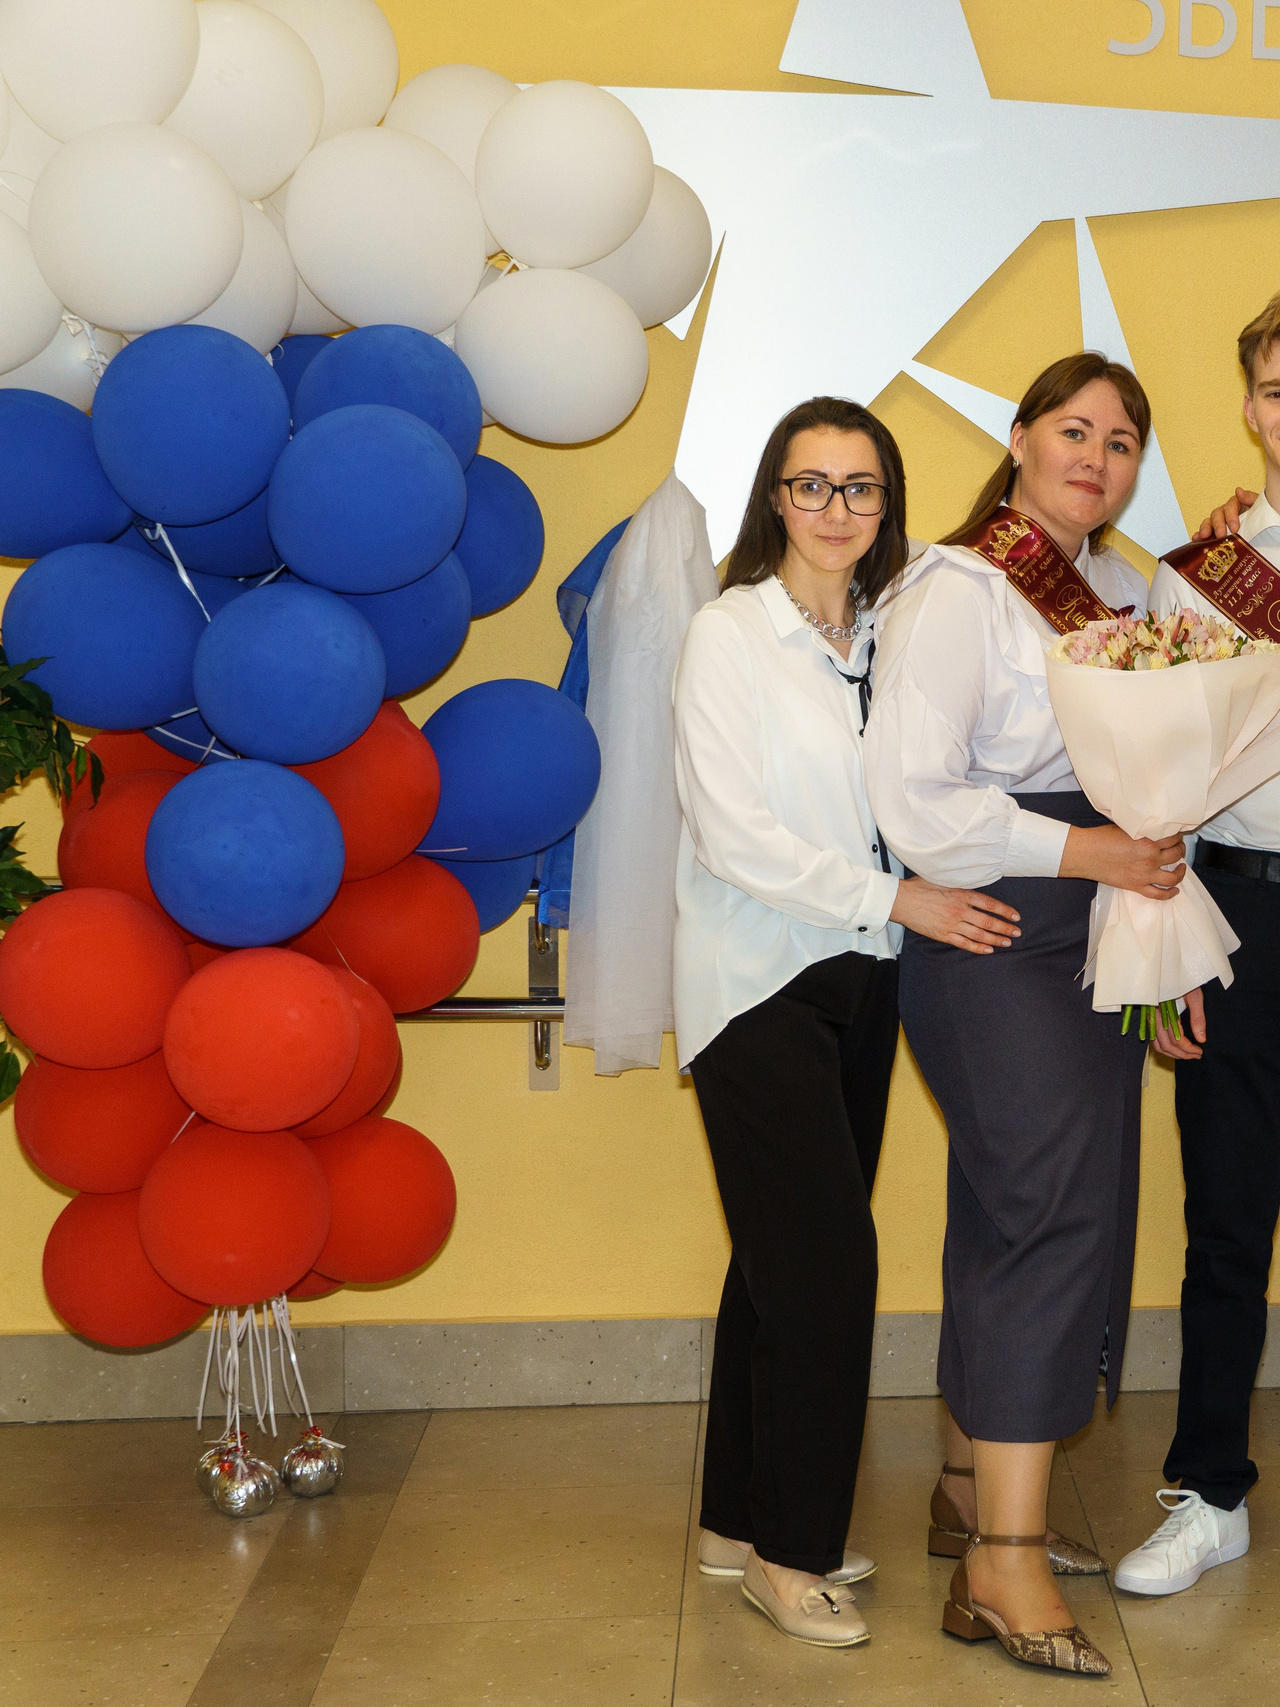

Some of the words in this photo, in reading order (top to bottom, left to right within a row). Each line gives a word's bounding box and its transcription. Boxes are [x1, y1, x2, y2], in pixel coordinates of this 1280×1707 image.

[1212, 575, 1234, 599] Лучший
[1244, 567, 1262, 589] класс
[1093, 604, 1111, 620] Боро
